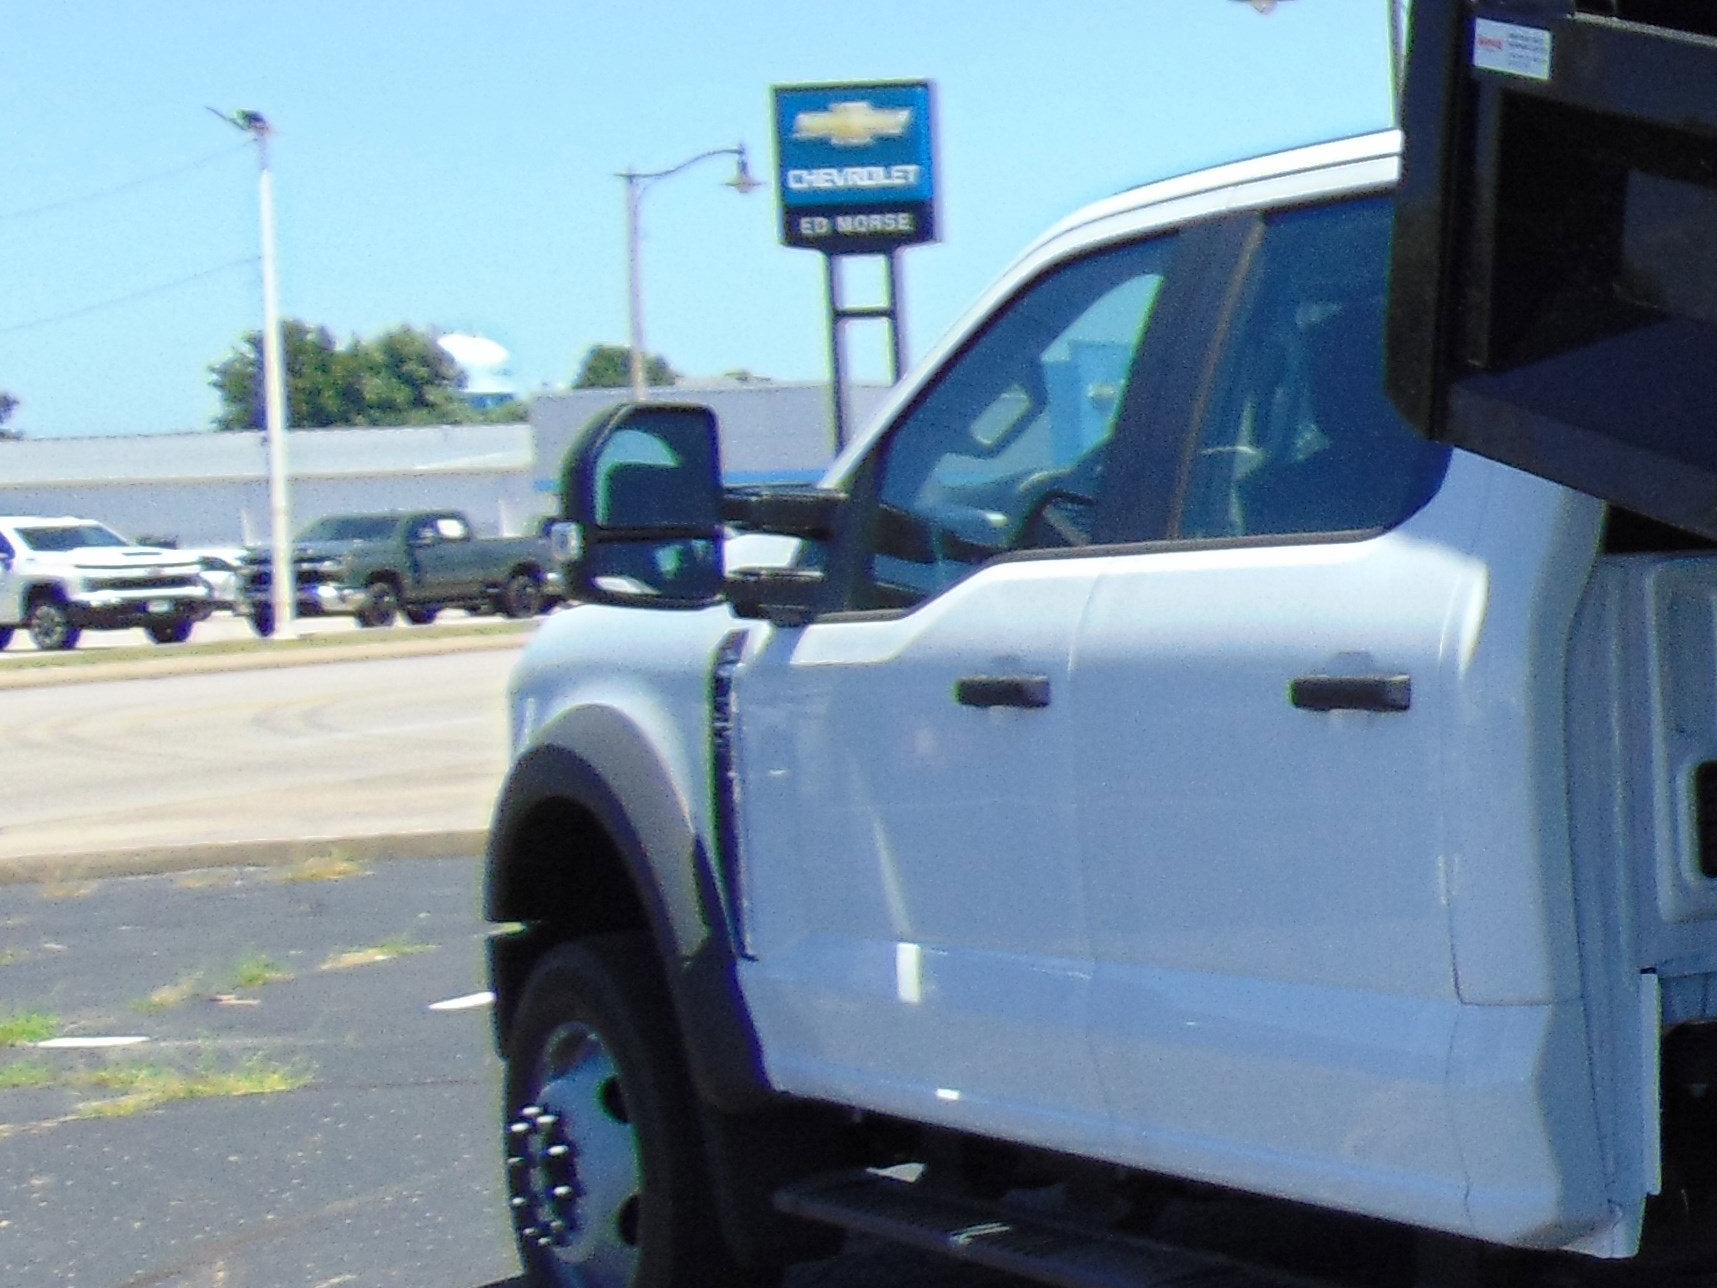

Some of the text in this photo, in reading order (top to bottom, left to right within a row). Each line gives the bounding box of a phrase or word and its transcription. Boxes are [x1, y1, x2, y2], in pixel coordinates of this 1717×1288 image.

[786, 165, 920, 189] CHEVROLET
[800, 212, 914, 234] ED MORSE
